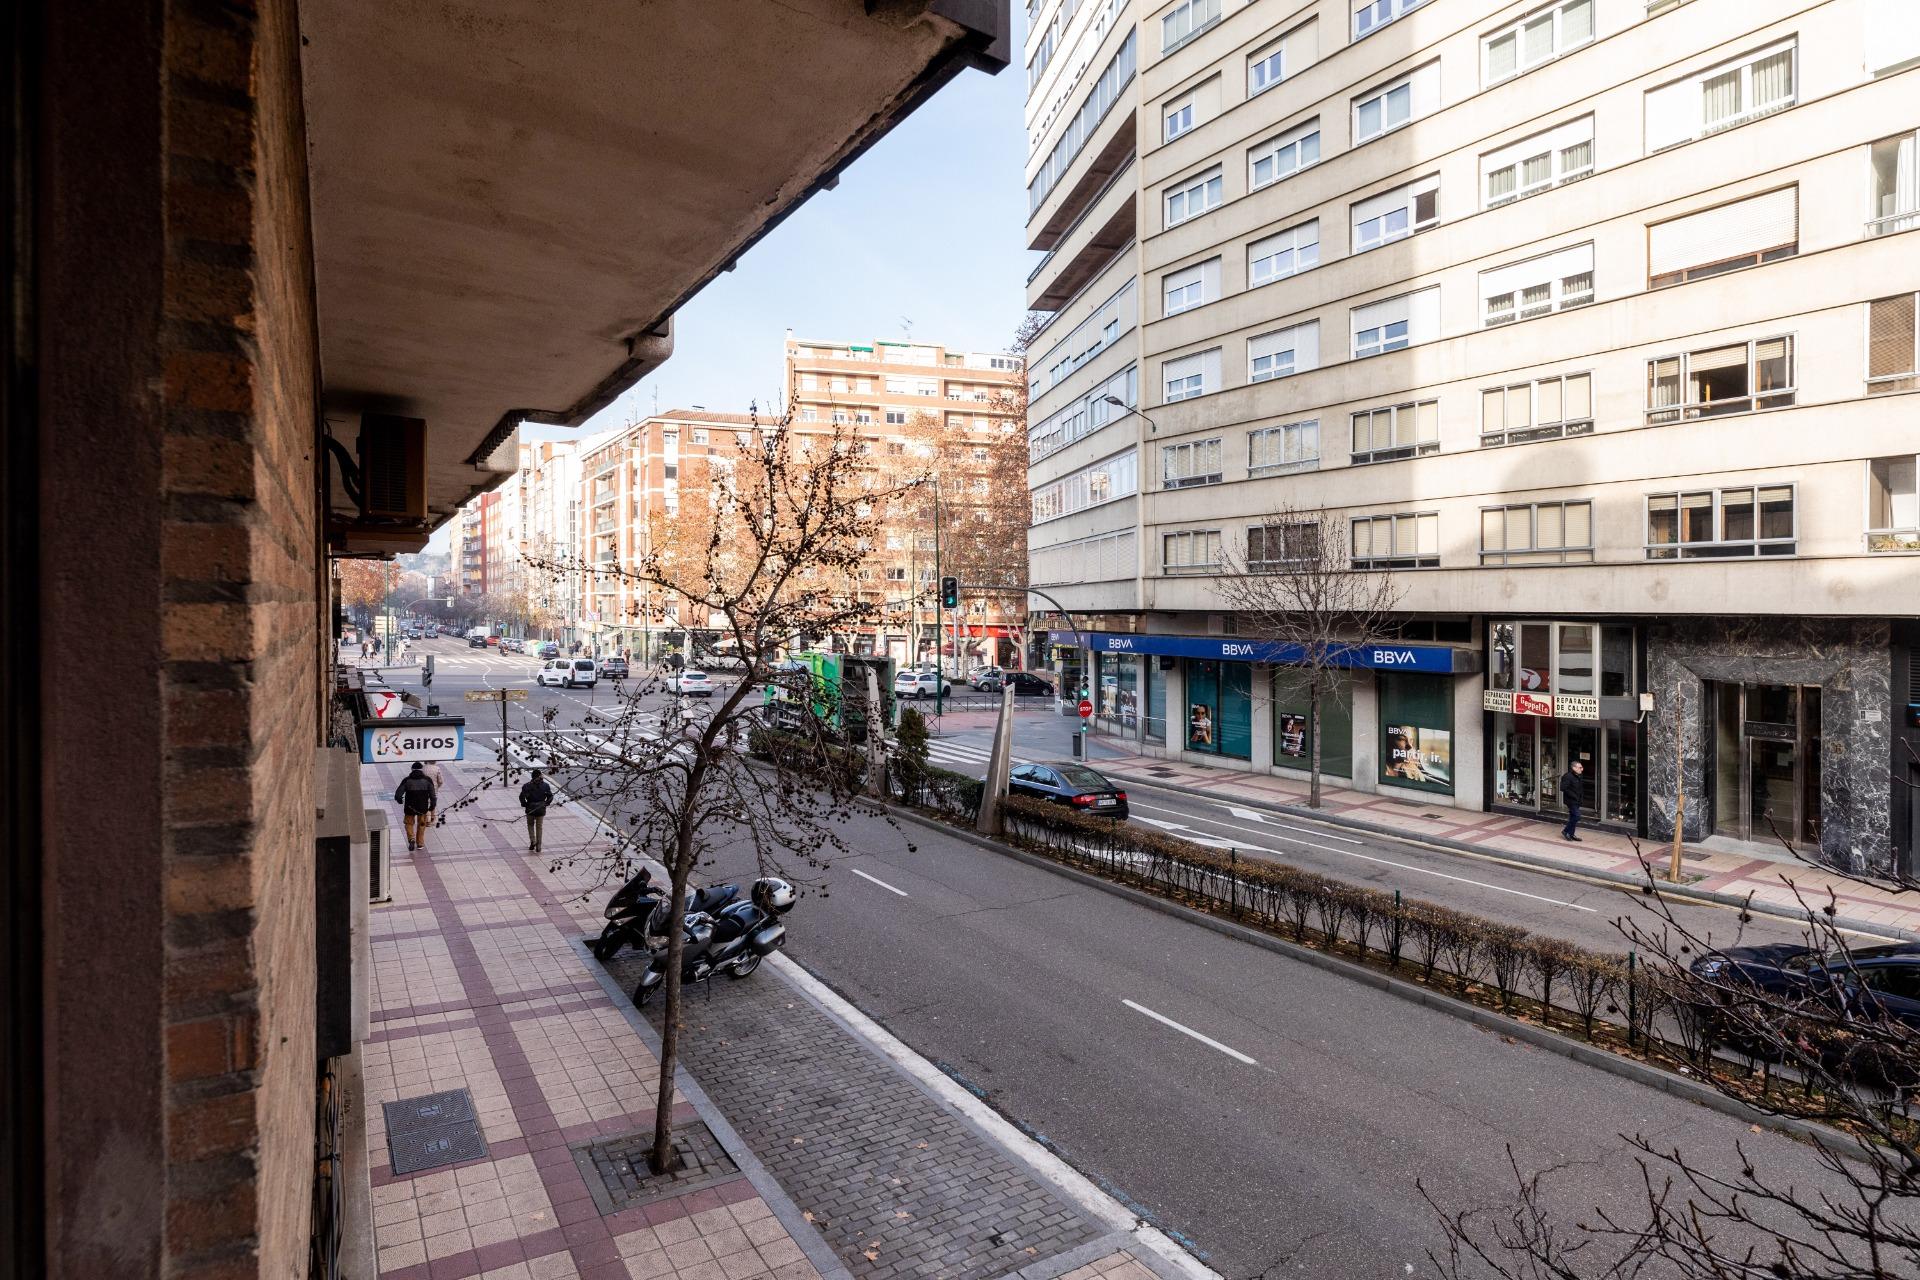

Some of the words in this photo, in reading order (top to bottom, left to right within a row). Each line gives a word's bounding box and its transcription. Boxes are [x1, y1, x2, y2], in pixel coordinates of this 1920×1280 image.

[1108, 638, 1133, 649] BBVA
[1222, 643, 1254, 656] BBVA
[1374, 650, 1416, 664] BBVA
[1556, 697, 1597, 705] REPARACION
[1388, 727, 1408, 735] BBVA
[377, 731, 454, 755] Kairos
